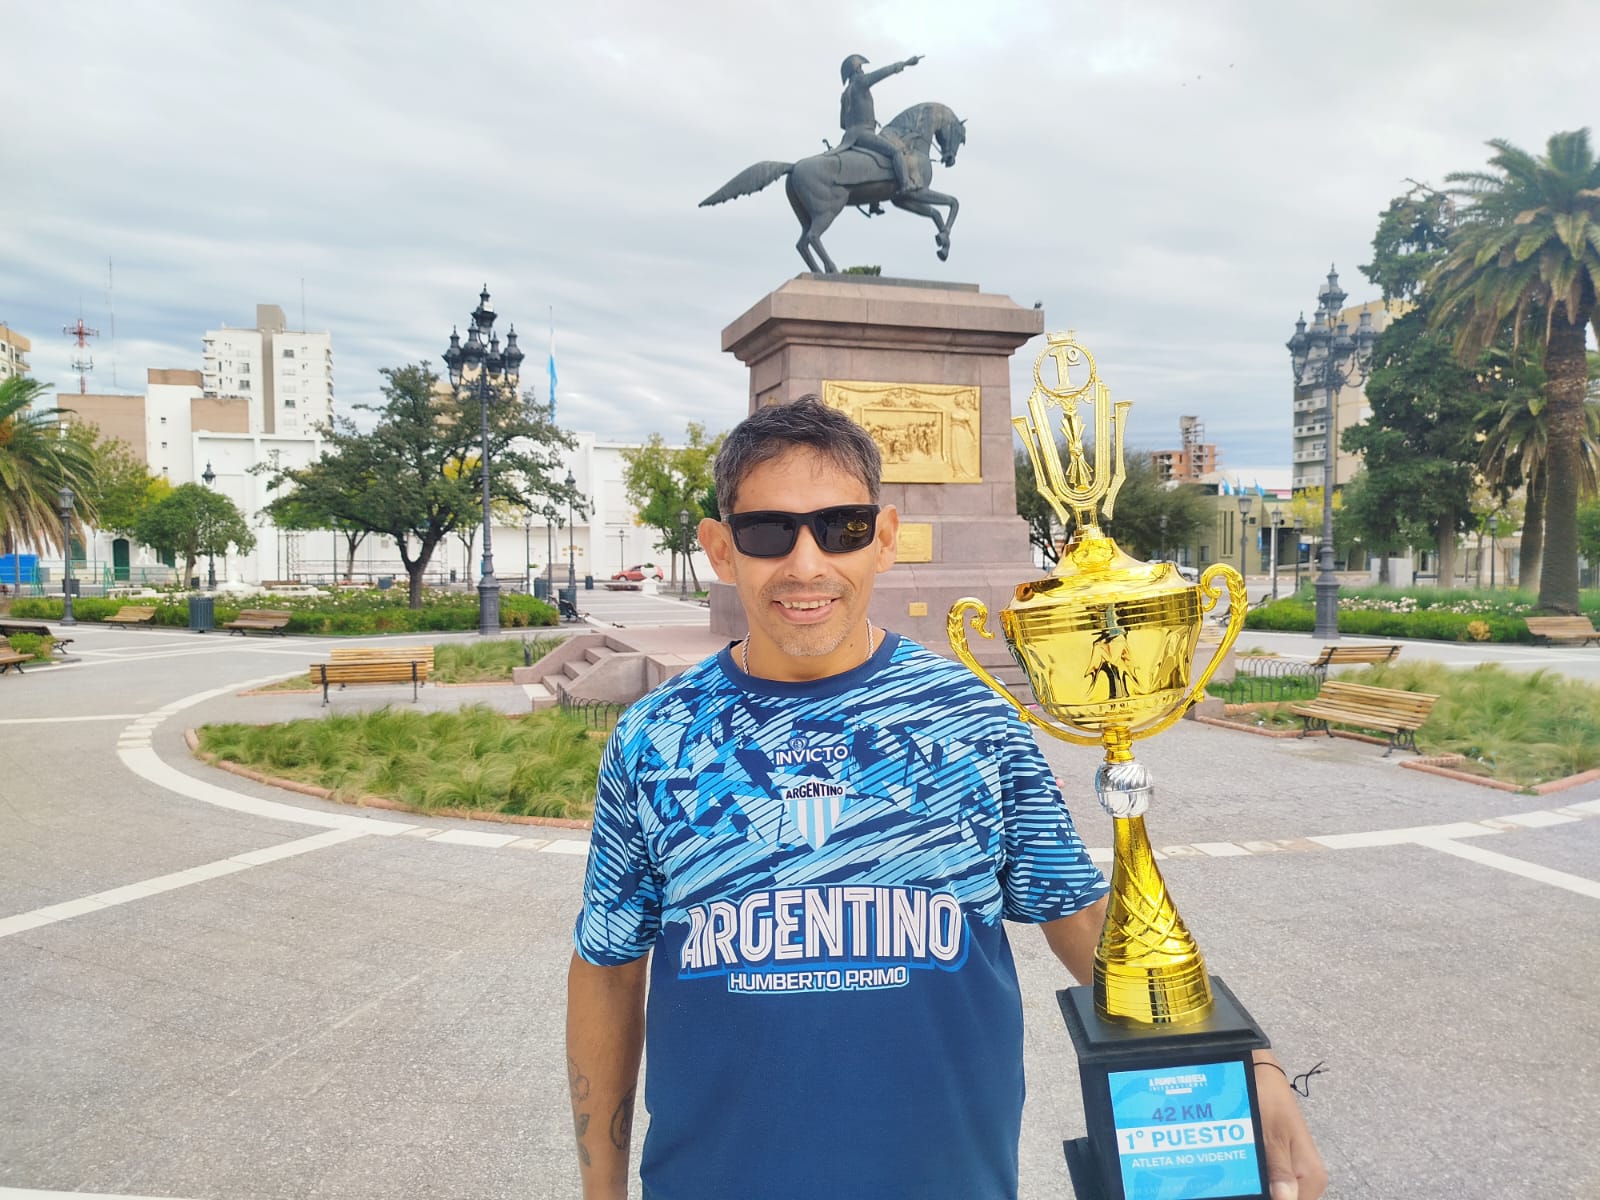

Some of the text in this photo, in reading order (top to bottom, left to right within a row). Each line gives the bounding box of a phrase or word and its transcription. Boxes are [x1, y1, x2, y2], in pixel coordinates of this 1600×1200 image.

[776, 745, 848, 765] INVICTO
[786, 782, 843, 799] ARGENTINO
[681, 886, 962, 969] ARGENTINO
[730, 966, 907, 990] HUMBERTO PRIMO
[1152, 1103, 1214, 1122] 42 KM
[1151, 1124, 1245, 1148] PUESTO
[1132, 1149, 1247, 1168] ATLETA NO VIDENTE
